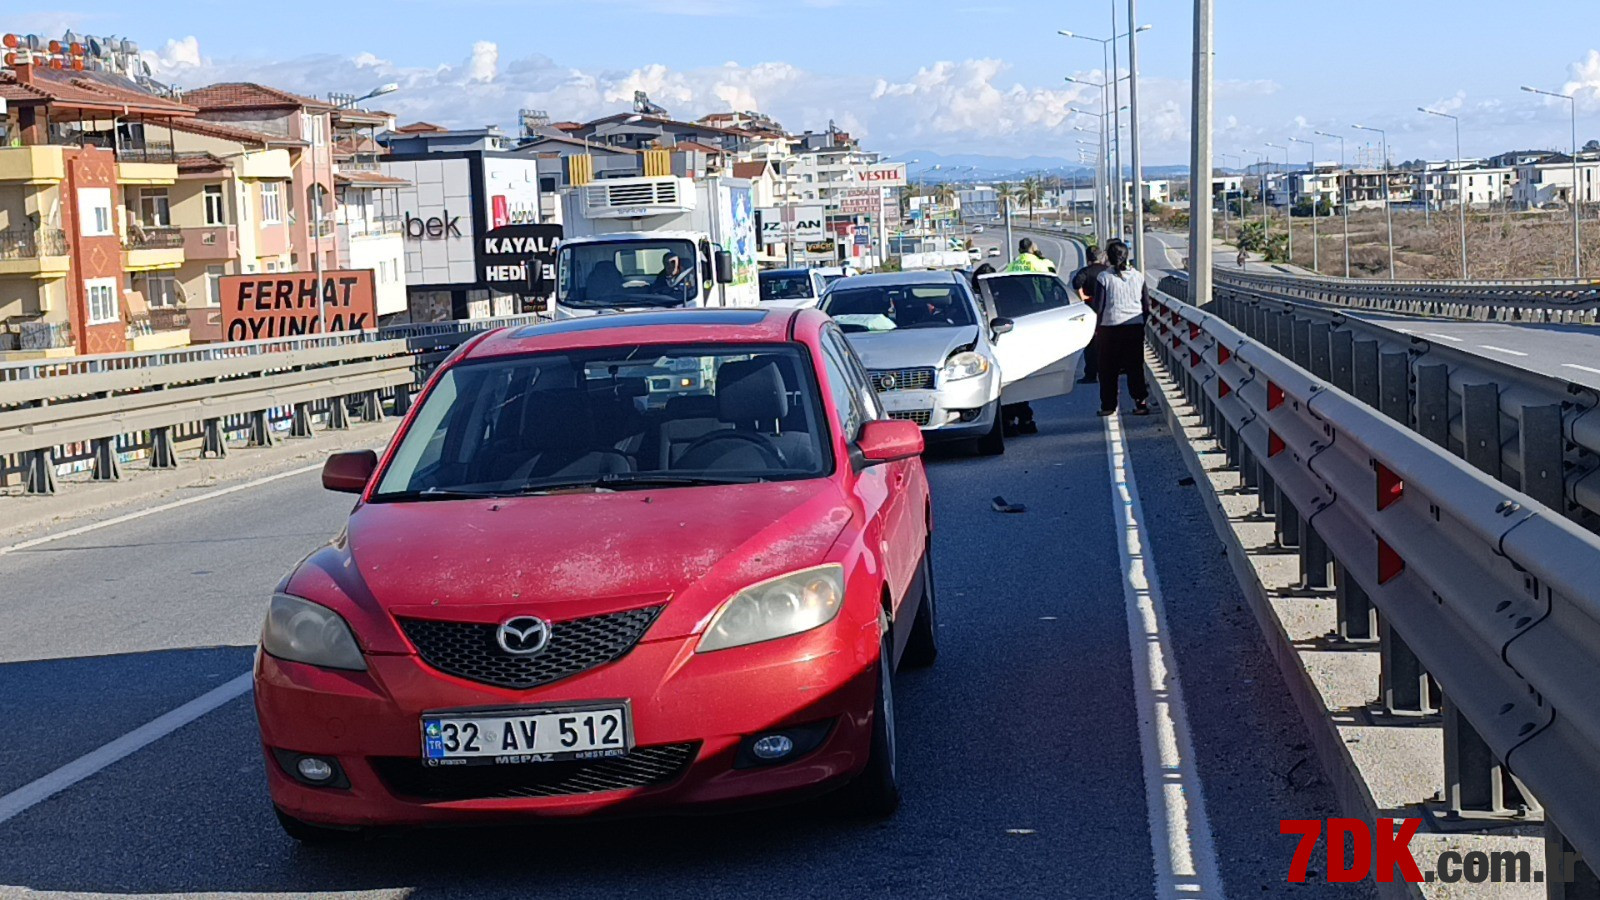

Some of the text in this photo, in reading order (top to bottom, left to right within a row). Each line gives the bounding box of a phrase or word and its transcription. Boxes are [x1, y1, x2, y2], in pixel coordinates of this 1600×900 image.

[858, 169, 900, 181] VESTEL
[401, 210, 462, 237] bek
[485, 260, 556, 281] HEDİEL
[237, 276, 357, 311] FERHAT
[442, 714, 619, 752] 32 AV 512
[428, 740, 442, 750] TR
[495, 753, 554, 764] MEPAZ
